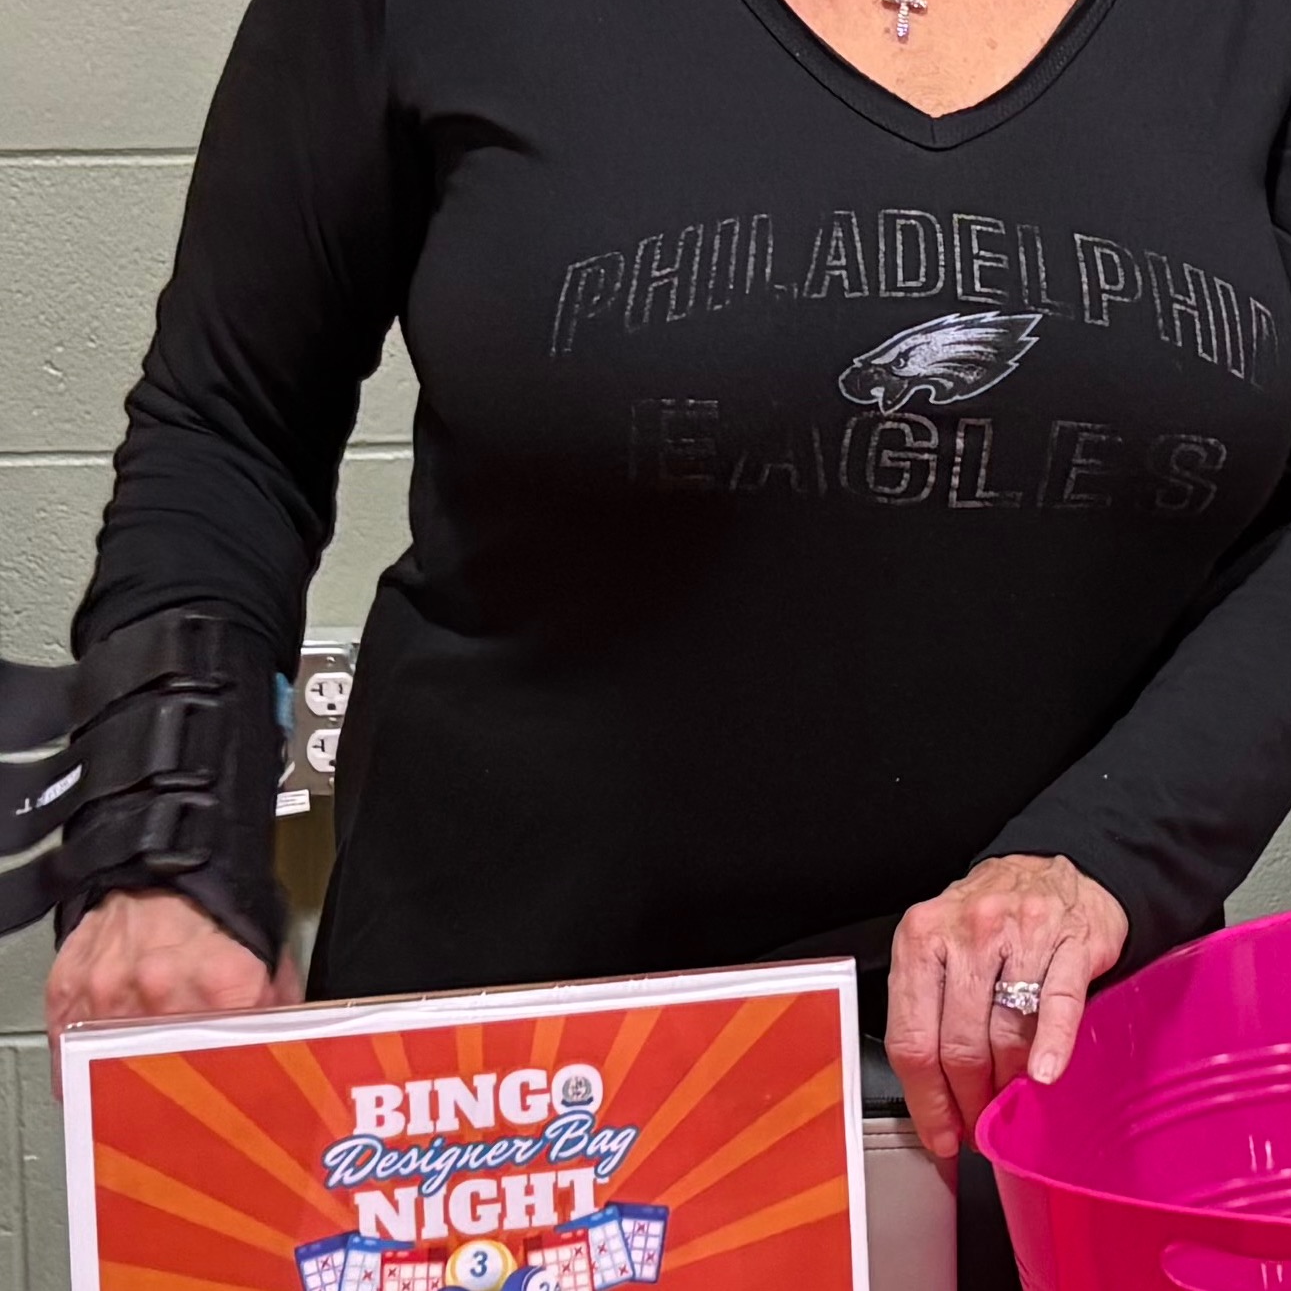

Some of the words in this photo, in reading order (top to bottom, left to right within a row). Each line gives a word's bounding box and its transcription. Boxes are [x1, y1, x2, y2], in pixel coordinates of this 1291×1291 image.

[630, 399, 1228, 512] EAGLES
[351, 1064, 603, 1139] BINGO
[325, 1135, 543, 1196] Designer
[545, 1111, 638, 1177] Bag
[354, 1166, 609, 1242] NIGHT
[470, 1250, 488, 1278] 3
